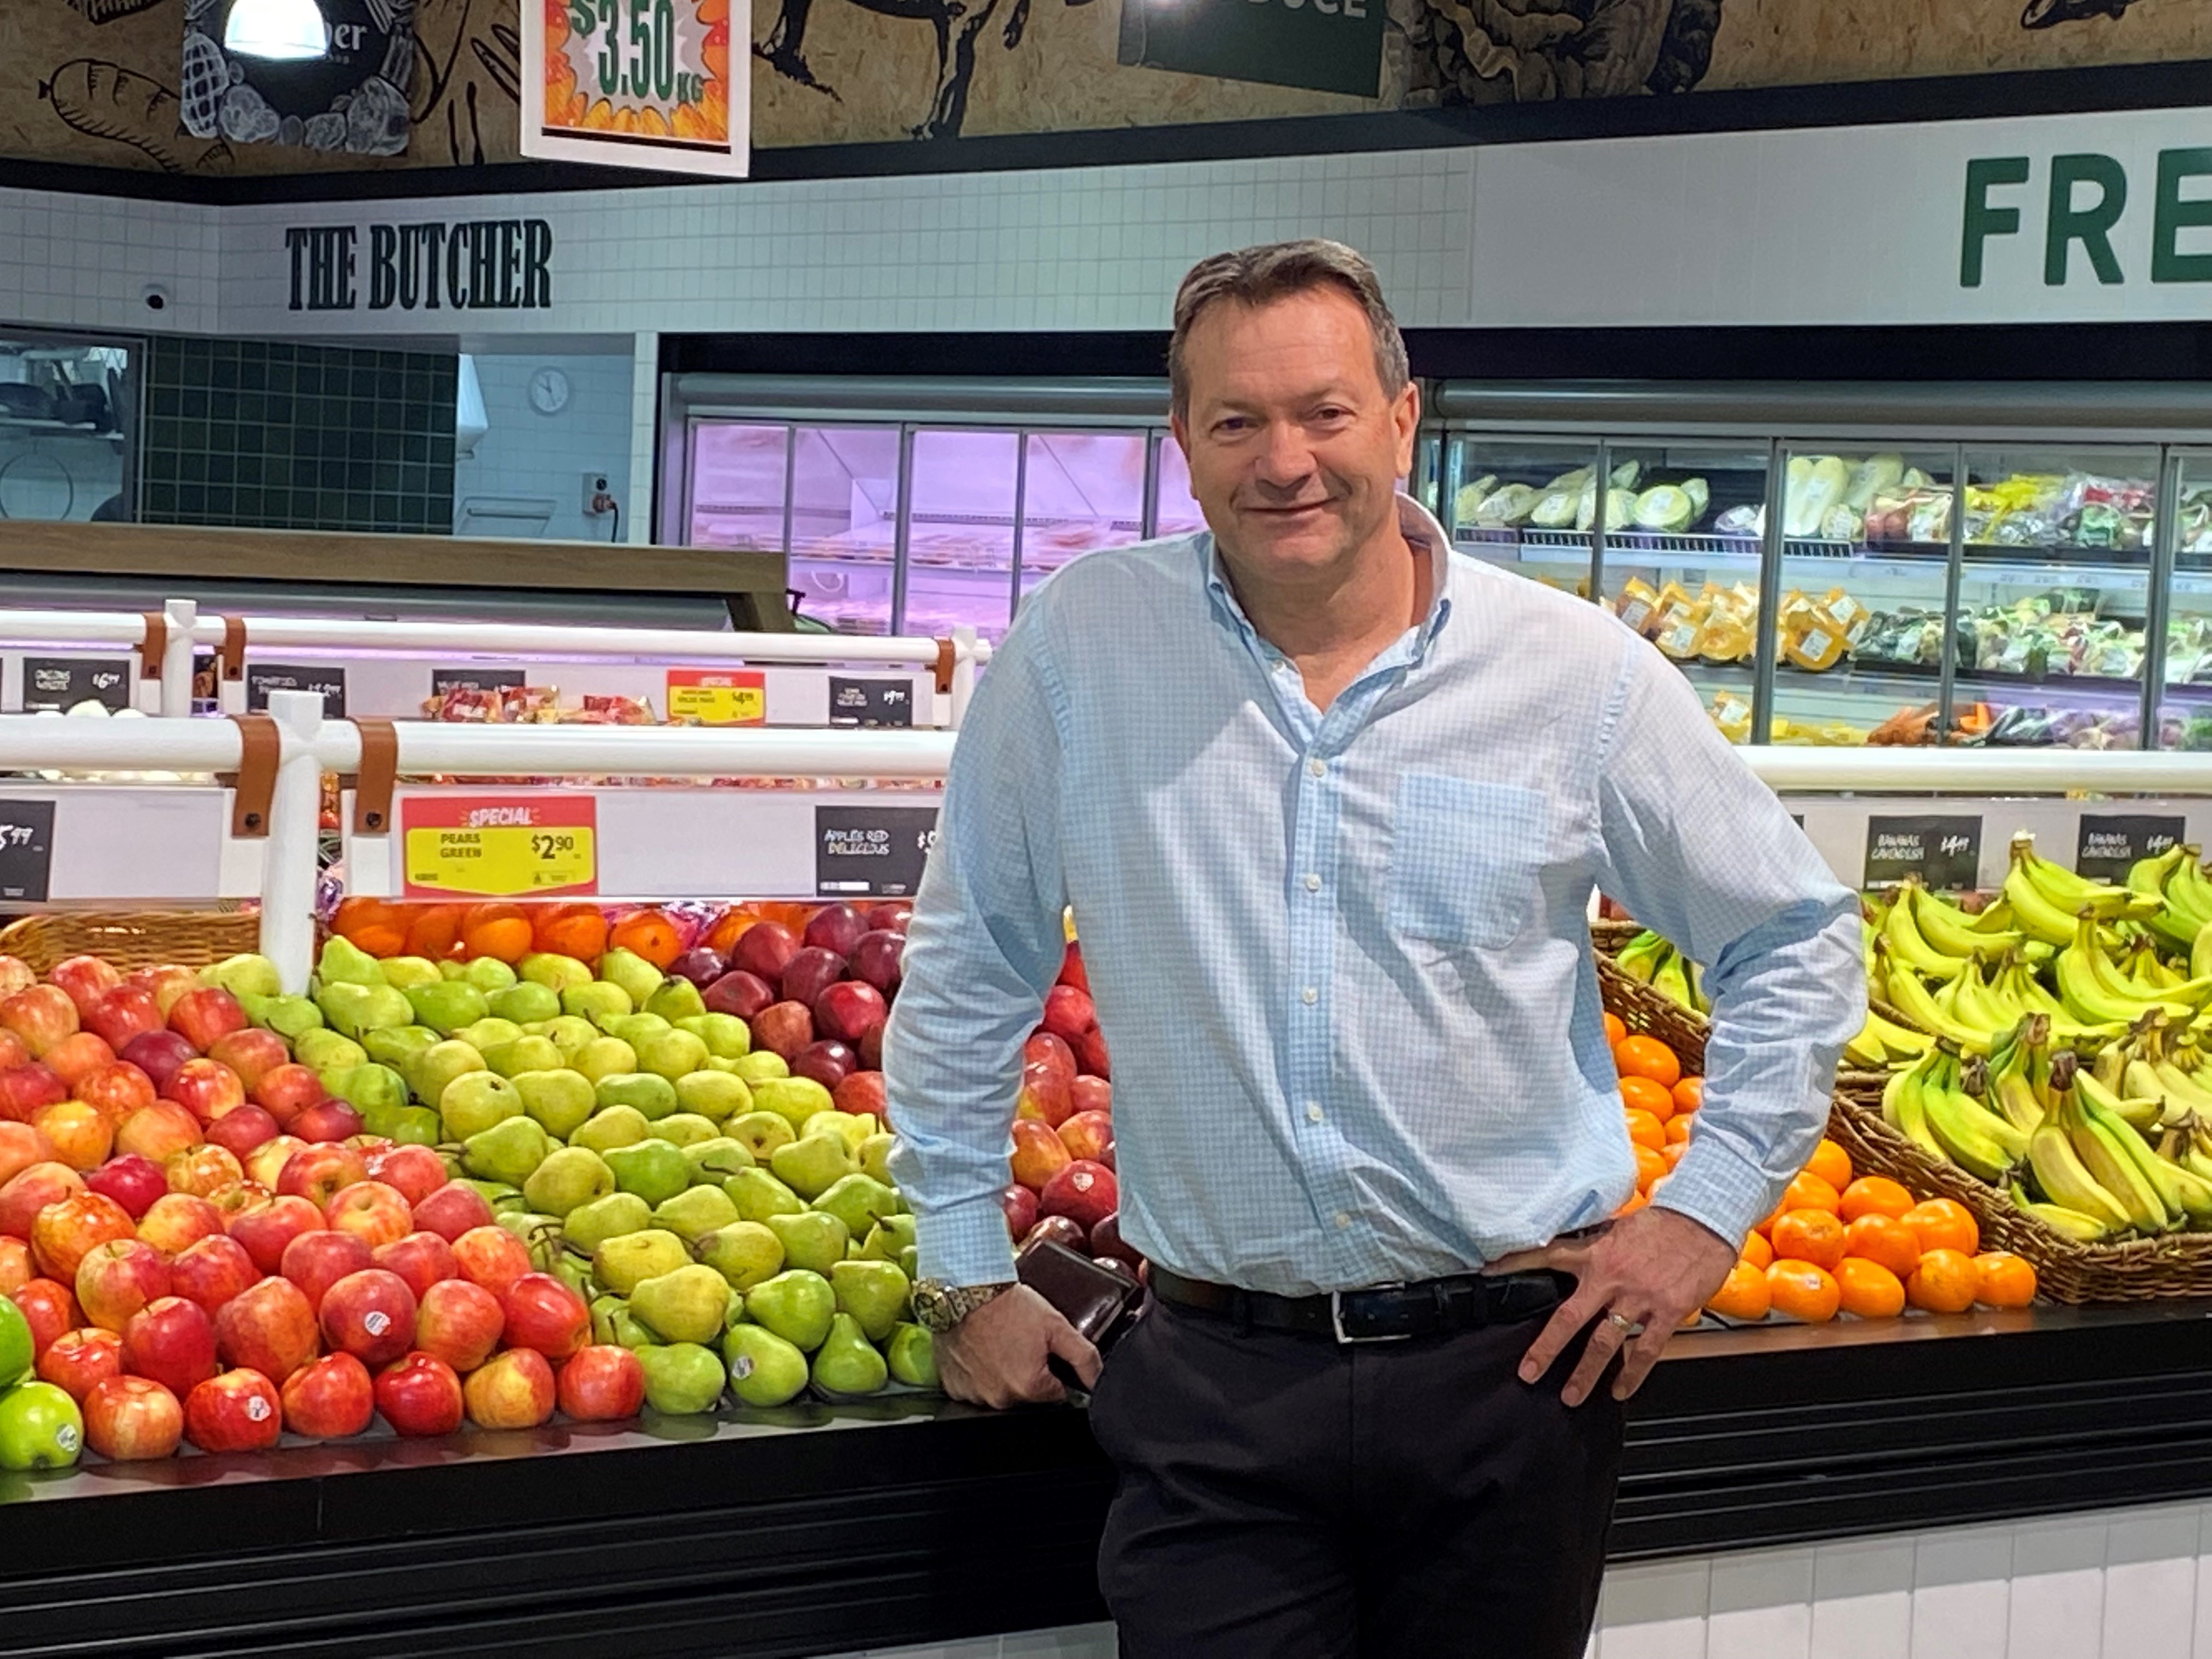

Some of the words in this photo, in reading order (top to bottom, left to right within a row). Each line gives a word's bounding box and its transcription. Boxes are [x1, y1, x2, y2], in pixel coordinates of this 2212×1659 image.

[1960, 147, 2212, 288] FRE
[285, 225, 357, 311] THE
[368, 218, 552, 310] BUTCHER
[469, 807, 533, 827] SPECIAL
[441, 833, 481, 844] PEARS
[440, 848, 482, 858] GREEN
